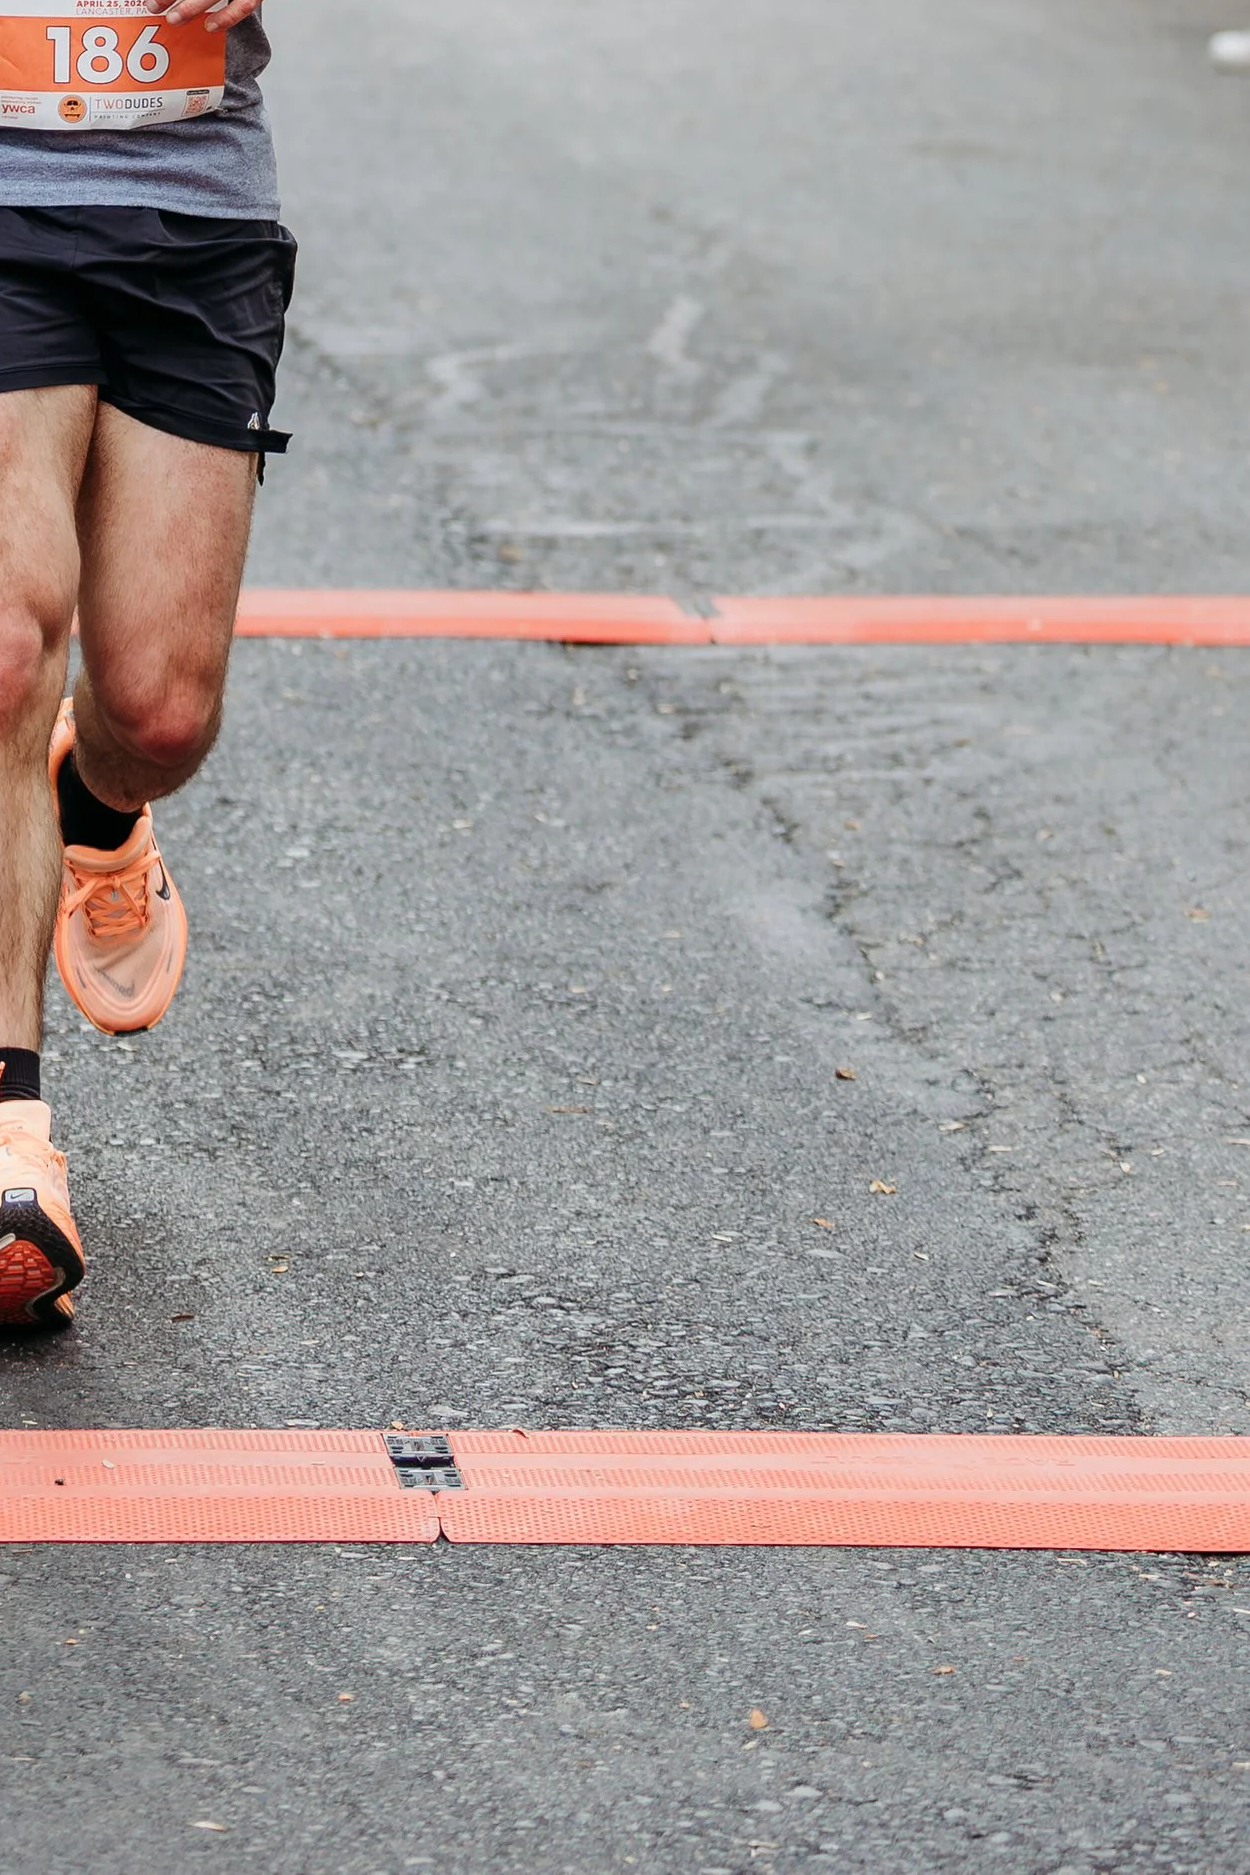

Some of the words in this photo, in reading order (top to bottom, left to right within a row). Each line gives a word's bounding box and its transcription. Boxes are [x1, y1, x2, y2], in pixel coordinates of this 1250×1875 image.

[106, 0, 121, 8] 25,
[76, 7, 133, 16] LANCASTER,
[136, 7, 148, 15] PA
[46, 25, 170, 84] 186
[1, 104, 36, 114] ywca
